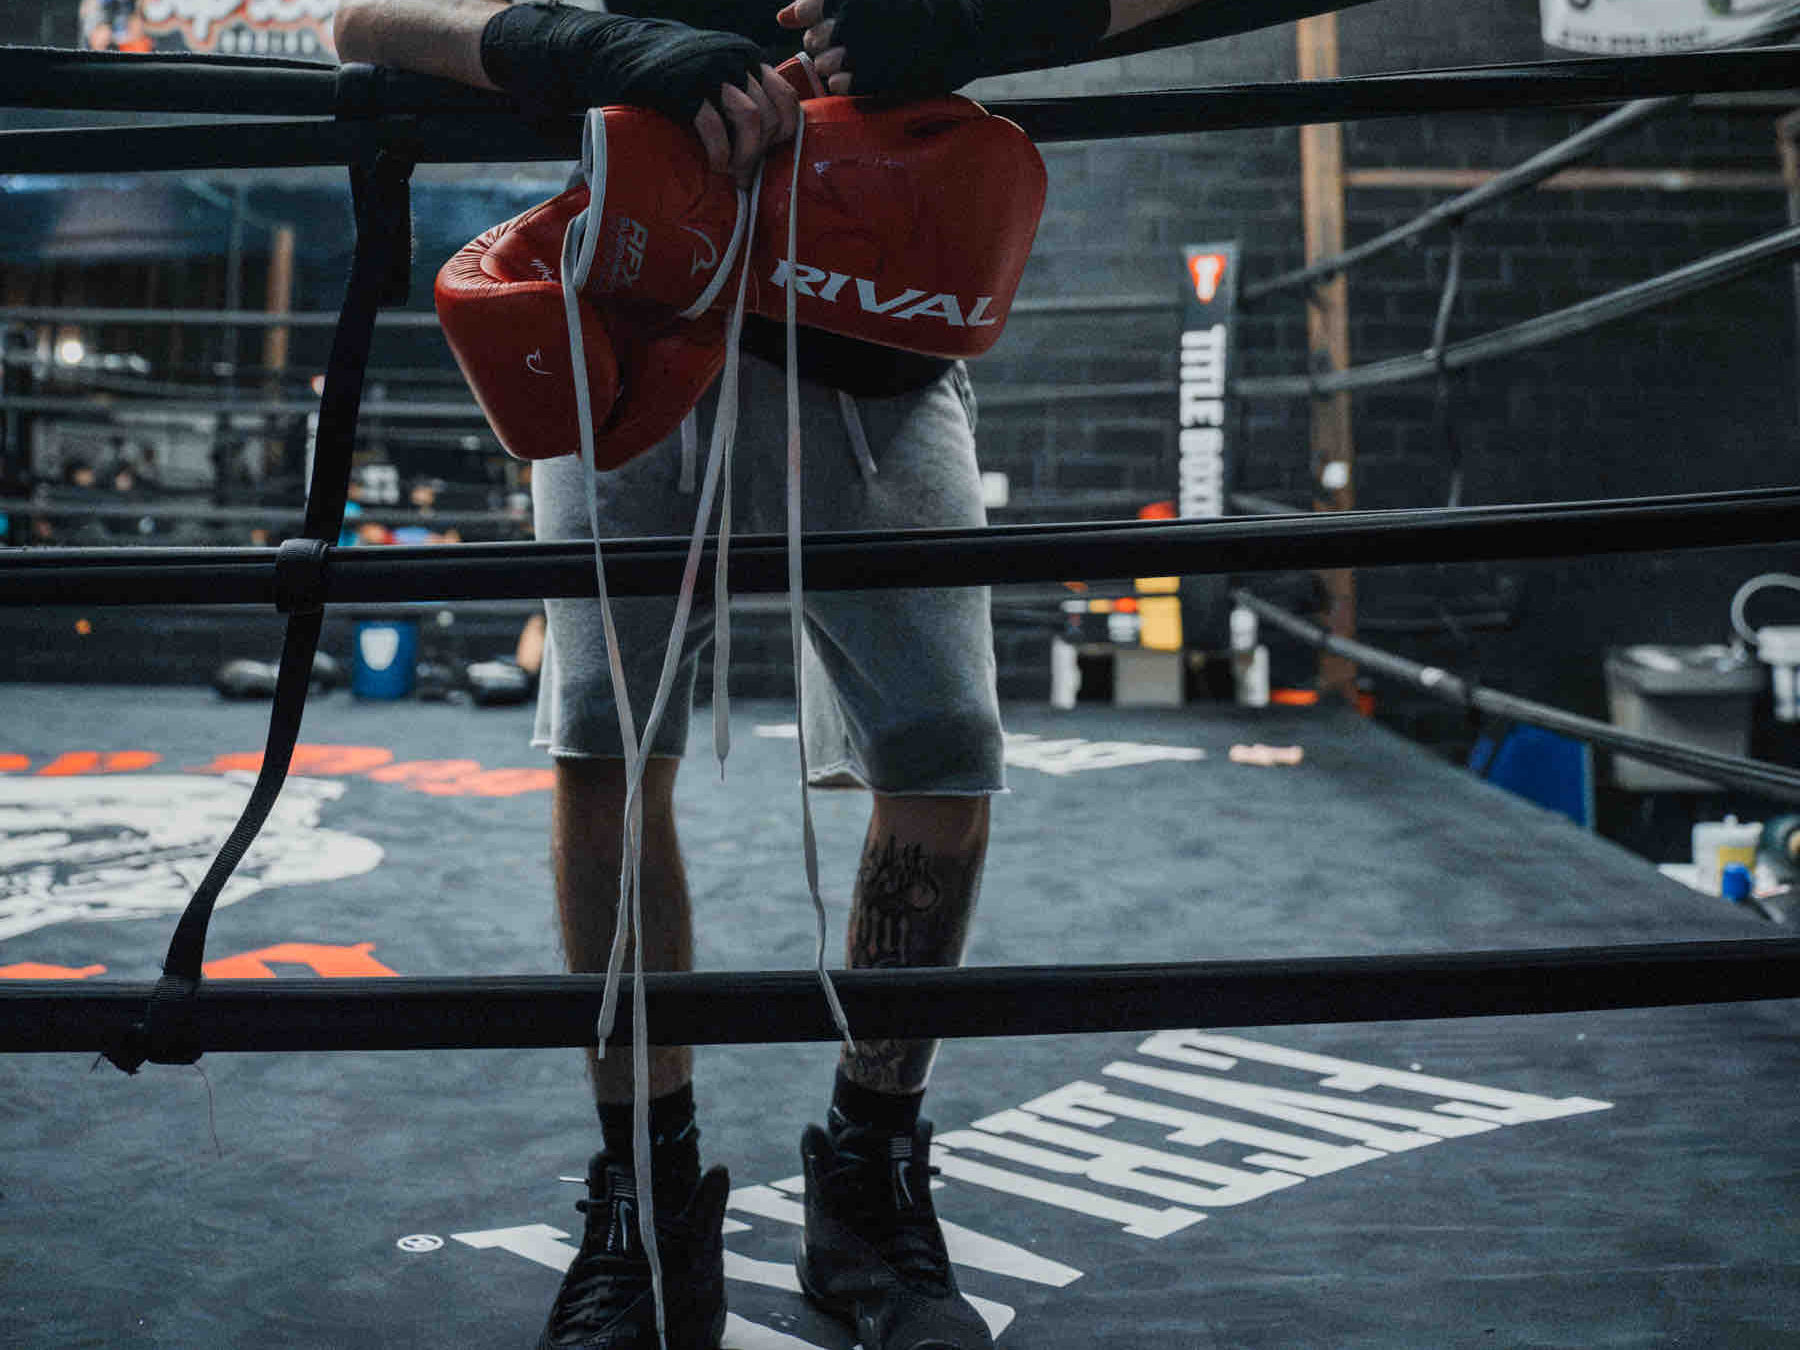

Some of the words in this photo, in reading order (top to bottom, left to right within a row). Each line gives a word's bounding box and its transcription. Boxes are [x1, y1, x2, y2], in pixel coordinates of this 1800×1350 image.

[770, 258, 999, 327] RIVAL
[1180, 324, 1226, 427] TITLE
[449, 1030, 1612, 1350] EVERLA
